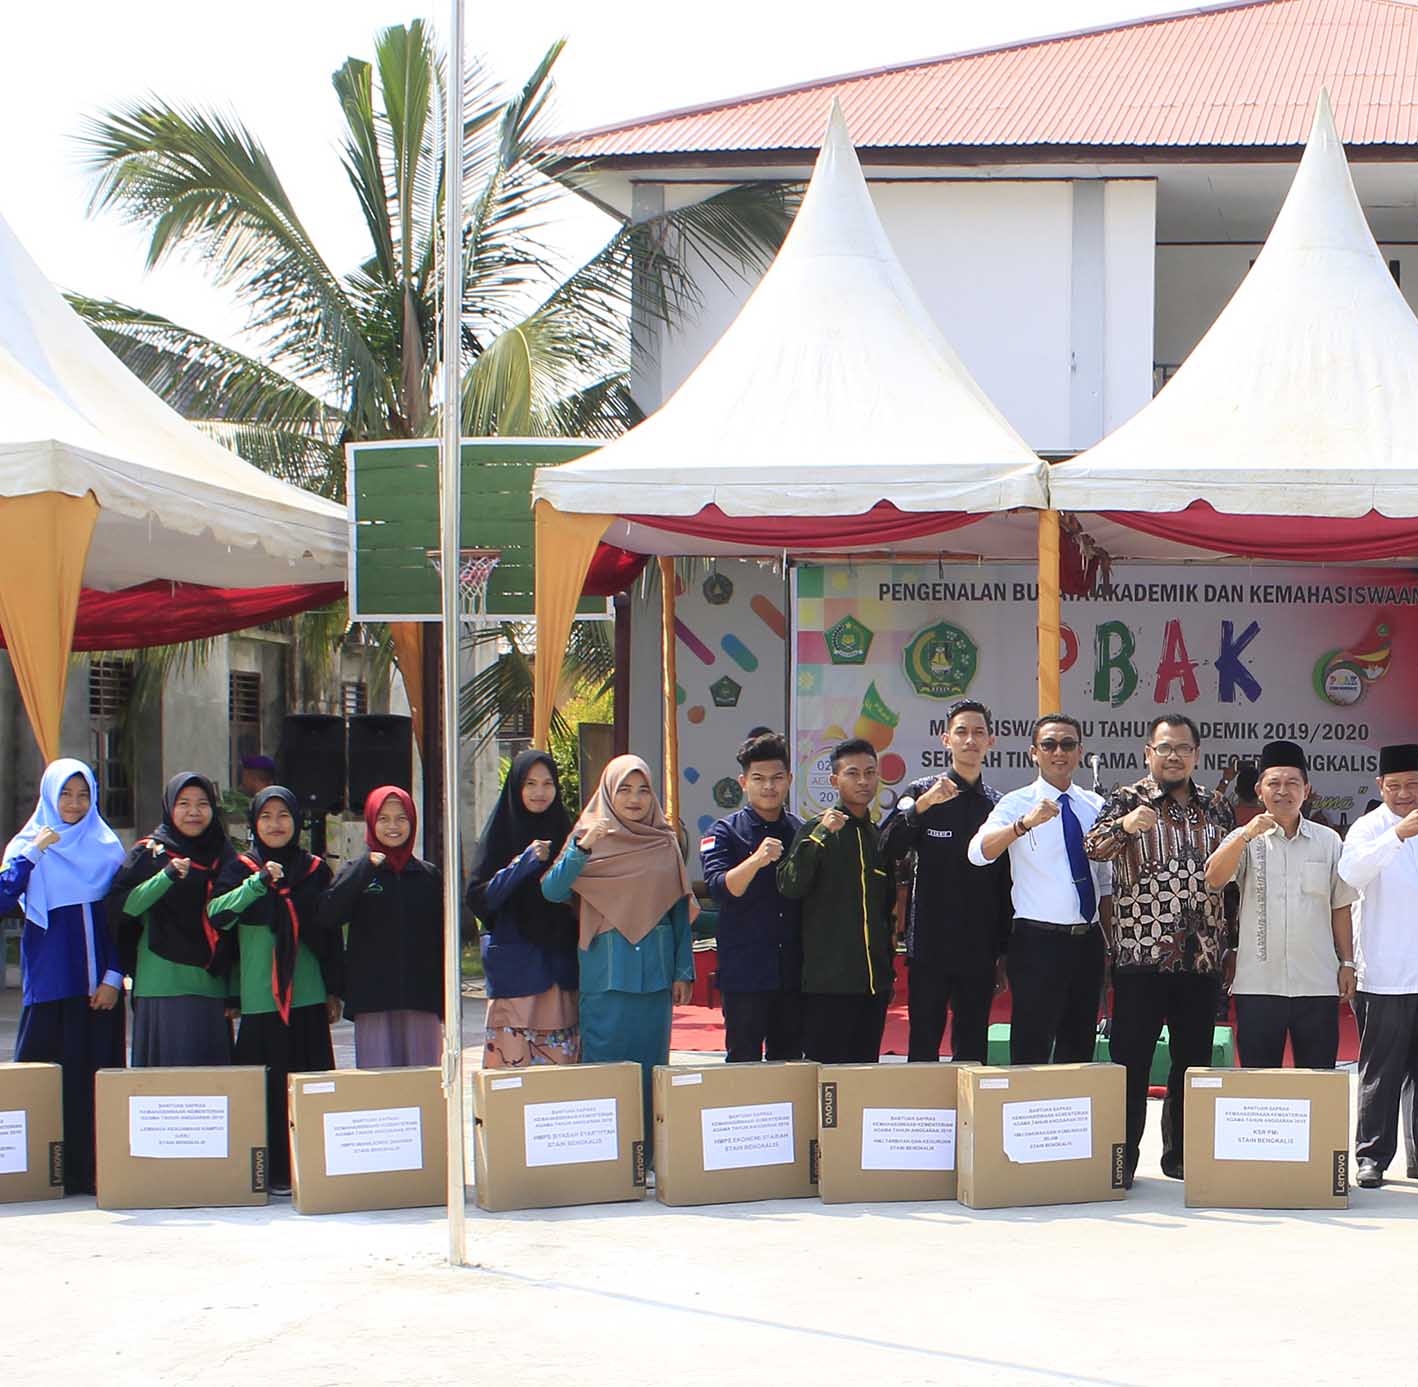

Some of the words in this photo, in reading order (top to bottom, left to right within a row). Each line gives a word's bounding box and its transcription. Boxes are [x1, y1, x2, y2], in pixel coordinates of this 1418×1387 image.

[879, 583, 1010, 601] PENGENALAN
[1094, 583, 1198, 602] AKADEMIK
[1204, 584, 1244, 602] DAN
[930, 719, 1036, 737] MSISW
[1199, 722, 1258, 739] DEMIK
[1264, 722, 1369, 743] 2019/2020
[921, 751, 1001, 768] SEKAH
[1305, 755, 1378, 772] NGKALIS
[825, 1085, 834, 1125] Lenovo
[255, 1150, 265, 1190] Lenovo
[635, 1144, 644, 1184] Lenovo
[1115, 1146, 1123, 1185] Lenovo
[1336, 1154, 1345, 1193] Lenovo
